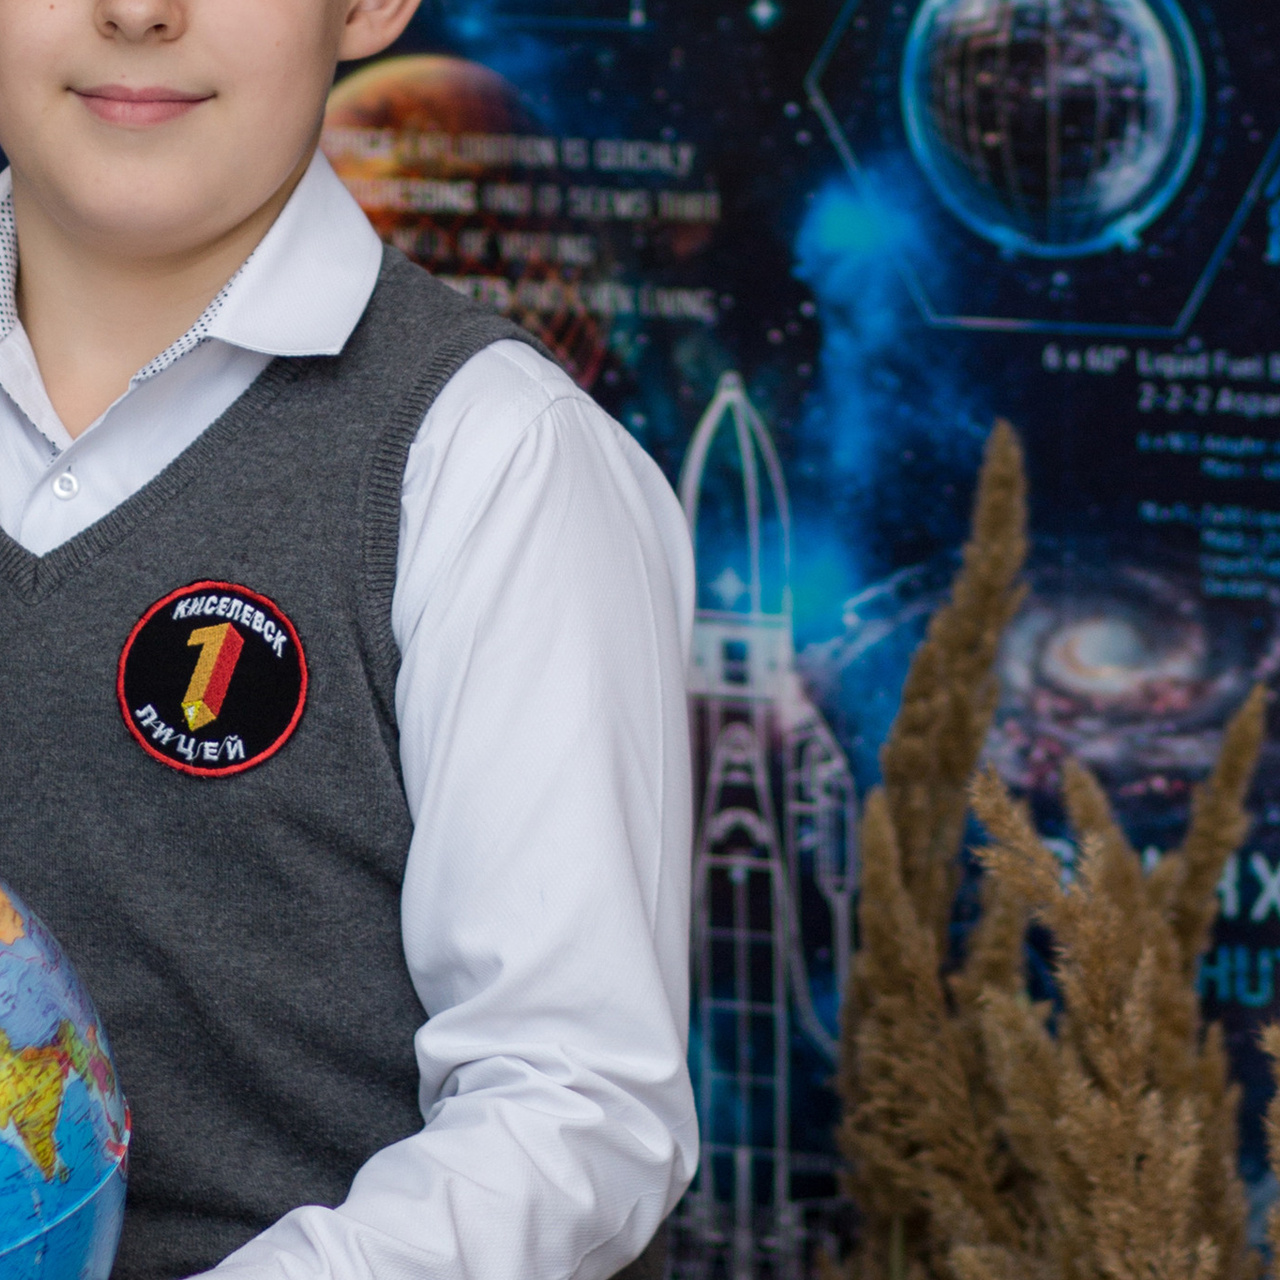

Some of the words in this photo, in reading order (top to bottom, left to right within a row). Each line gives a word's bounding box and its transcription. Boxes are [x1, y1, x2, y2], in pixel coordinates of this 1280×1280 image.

[172, 594, 288, 659] КИСЕЛЕВСК
[181, 622, 245, 732] 1
[135, 703, 246, 761] ЛИЦЕЙ
